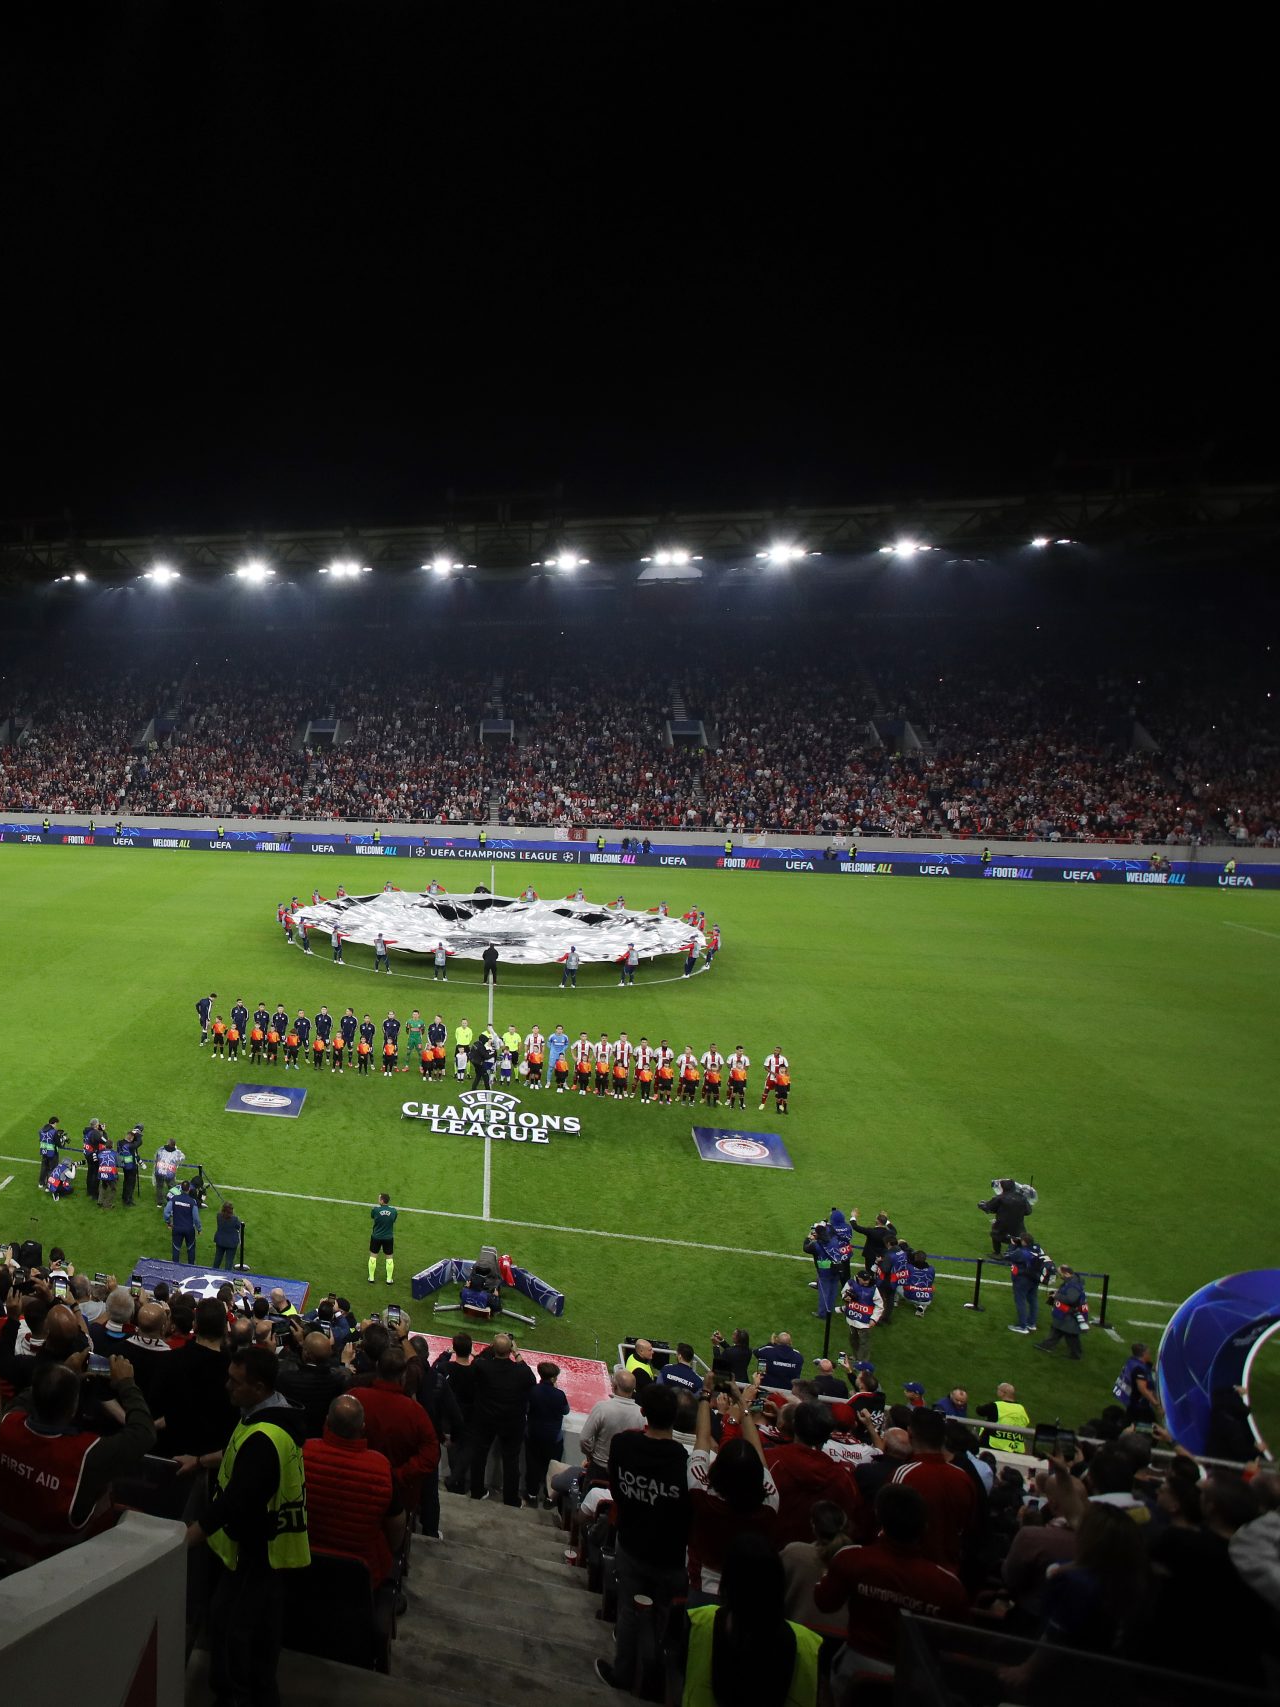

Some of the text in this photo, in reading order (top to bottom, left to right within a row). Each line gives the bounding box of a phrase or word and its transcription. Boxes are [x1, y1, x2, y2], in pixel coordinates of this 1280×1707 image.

[62, 835, 95, 845] #FOOTBALL
[112, 837, 134, 846] UEFA
[152, 838, 191, 848] WELCOME ALL
[209, 841, 232, 850] UEFA
[255, 842, 292, 852] #FOOTBALL
[311, 844, 335, 853] UEFA
[355, 845, 397, 856] WELCOME ALL
[430, 847, 558, 861] UEFA CHAMPIONS LEAGUE
[589, 853, 636, 865] WELCOME ALL
[660, 856, 687, 866] UEFA
[715, 857, 761, 869] #FOOTBALL
[785, 860, 814, 871] UEFA
[840, 862, 893, 874] WELCOME ALL
[919, 865, 950, 876] UEFA
[983, 867, 1034, 879] #FOOTBALL
[1063, 870, 1096, 881] UEFA
[1126, 871, 1186, 885] WELCOME ALL
[1218, 875, 1254, 887] UEFA
[460, 1092, 516, 1111] UEFA
[402, 1101, 581, 1132] CHAMPIONS
[430, 1118, 550, 1144] LEAGUE
[848, 1301, 869, 1313] HOTO
[0, 1453, 60, 1490] FIRST AID
[618, 1466, 680, 1498] LOCALS
[620, 1481, 658, 1506] ONLY
